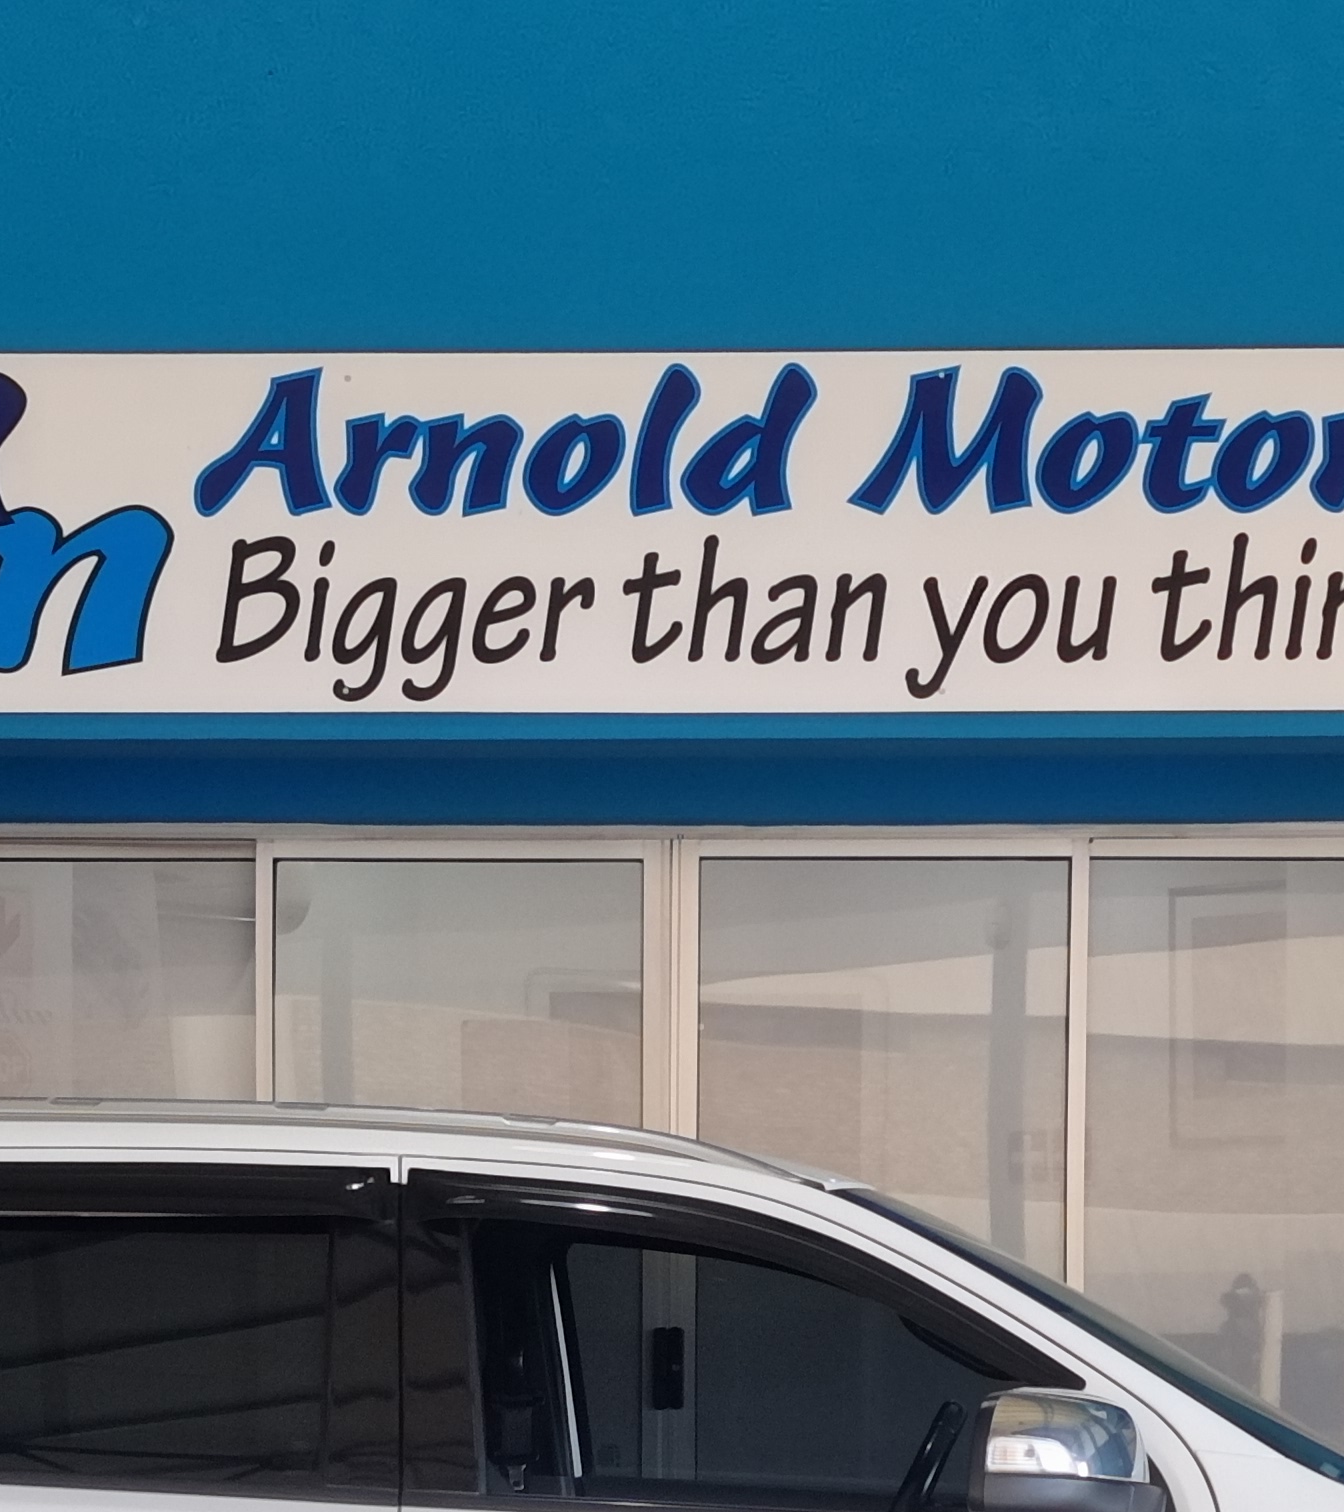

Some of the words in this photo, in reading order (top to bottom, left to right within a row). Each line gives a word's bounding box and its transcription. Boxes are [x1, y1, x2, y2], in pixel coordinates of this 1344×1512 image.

[194, 363, 817, 517] Arnold
[216, 536, 595, 702] Bigger
[623, 535, 887, 664] than
[905, 574, 1117, 699] you
